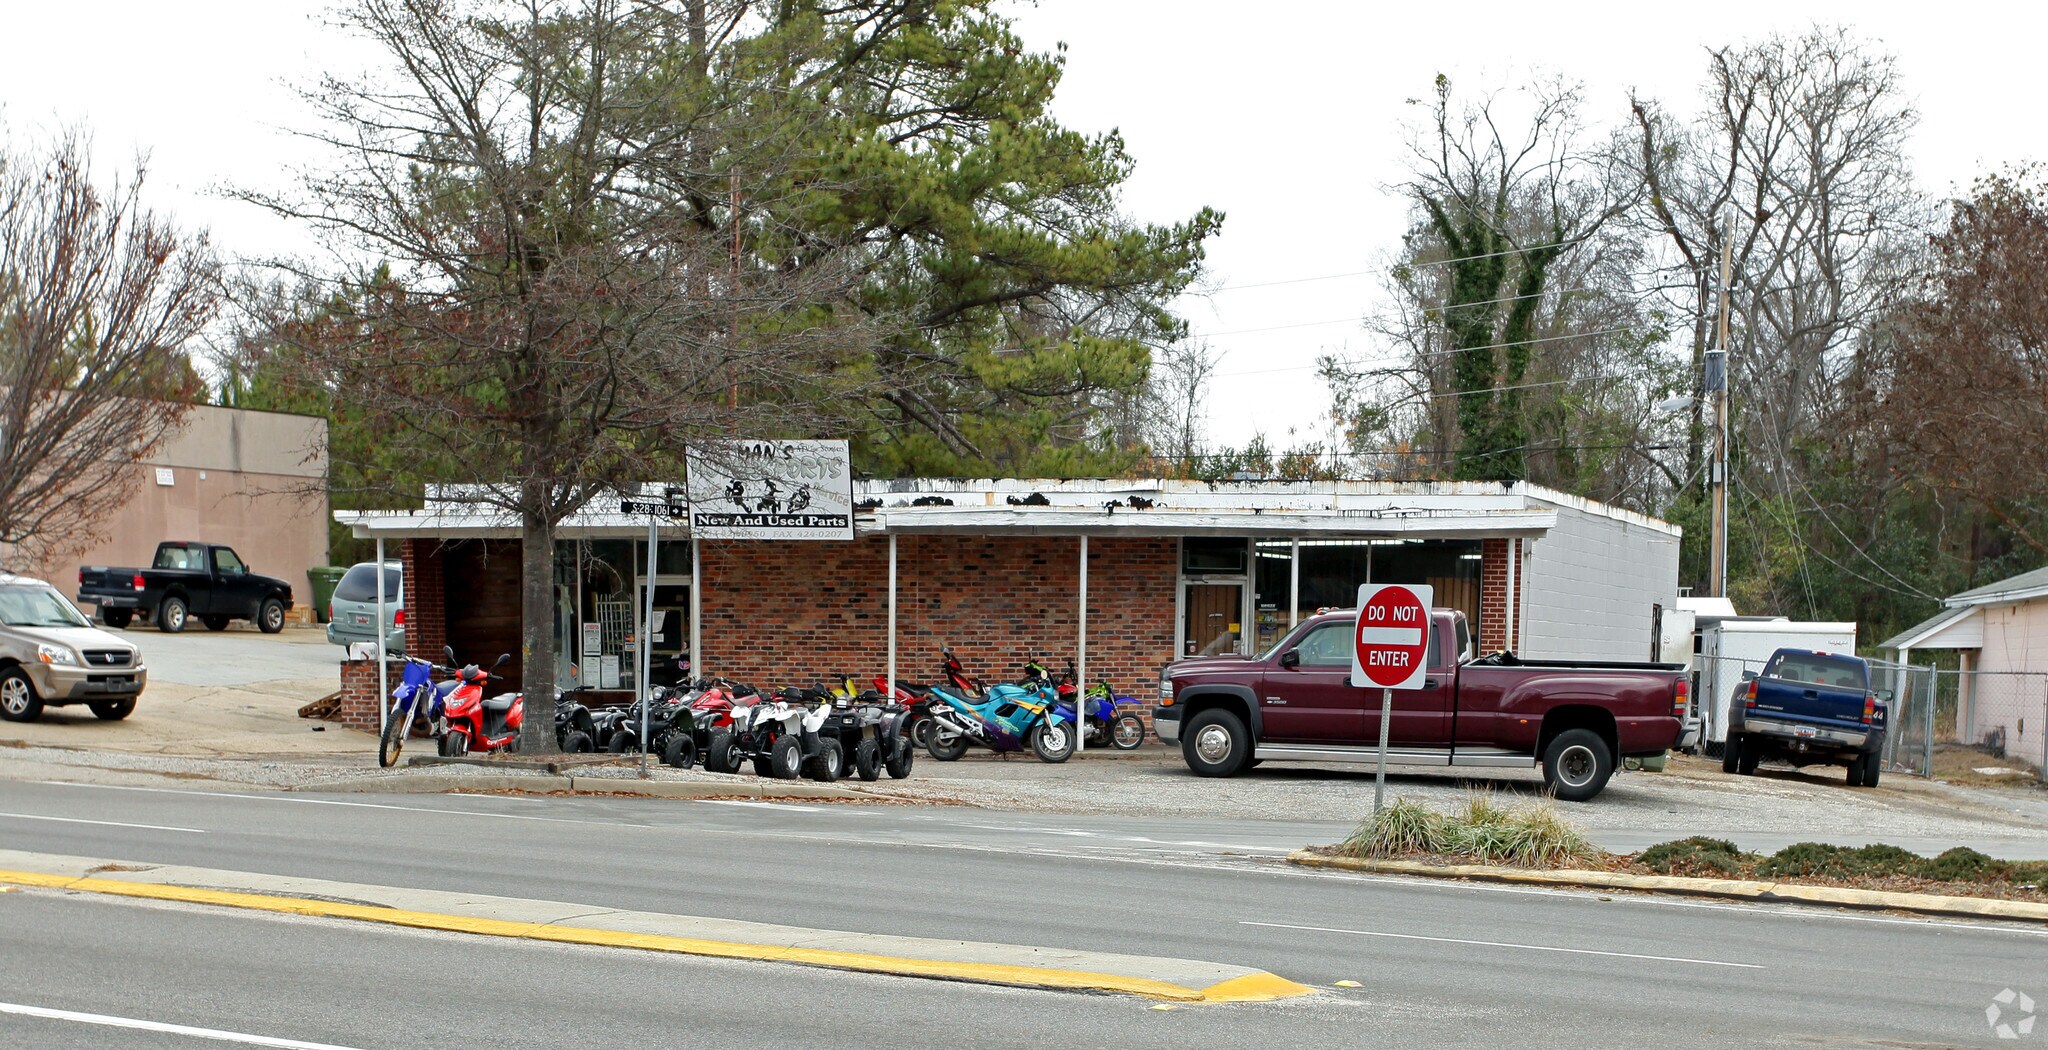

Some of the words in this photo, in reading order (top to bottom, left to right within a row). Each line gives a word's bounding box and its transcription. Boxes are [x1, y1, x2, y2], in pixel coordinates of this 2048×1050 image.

[697, 516, 730, 526] New
[734, 516, 764, 526] And
[767, 516, 805, 527] Used
[808, 516, 845, 527] Parts
[772, 530, 793, 539] FAX
[797, 530, 843, 539] 424-0207
[1368, 605, 1386, 621] DO
[1393, 605, 1419, 622] NOT
[1369, 650, 1410, 667] ENTER
